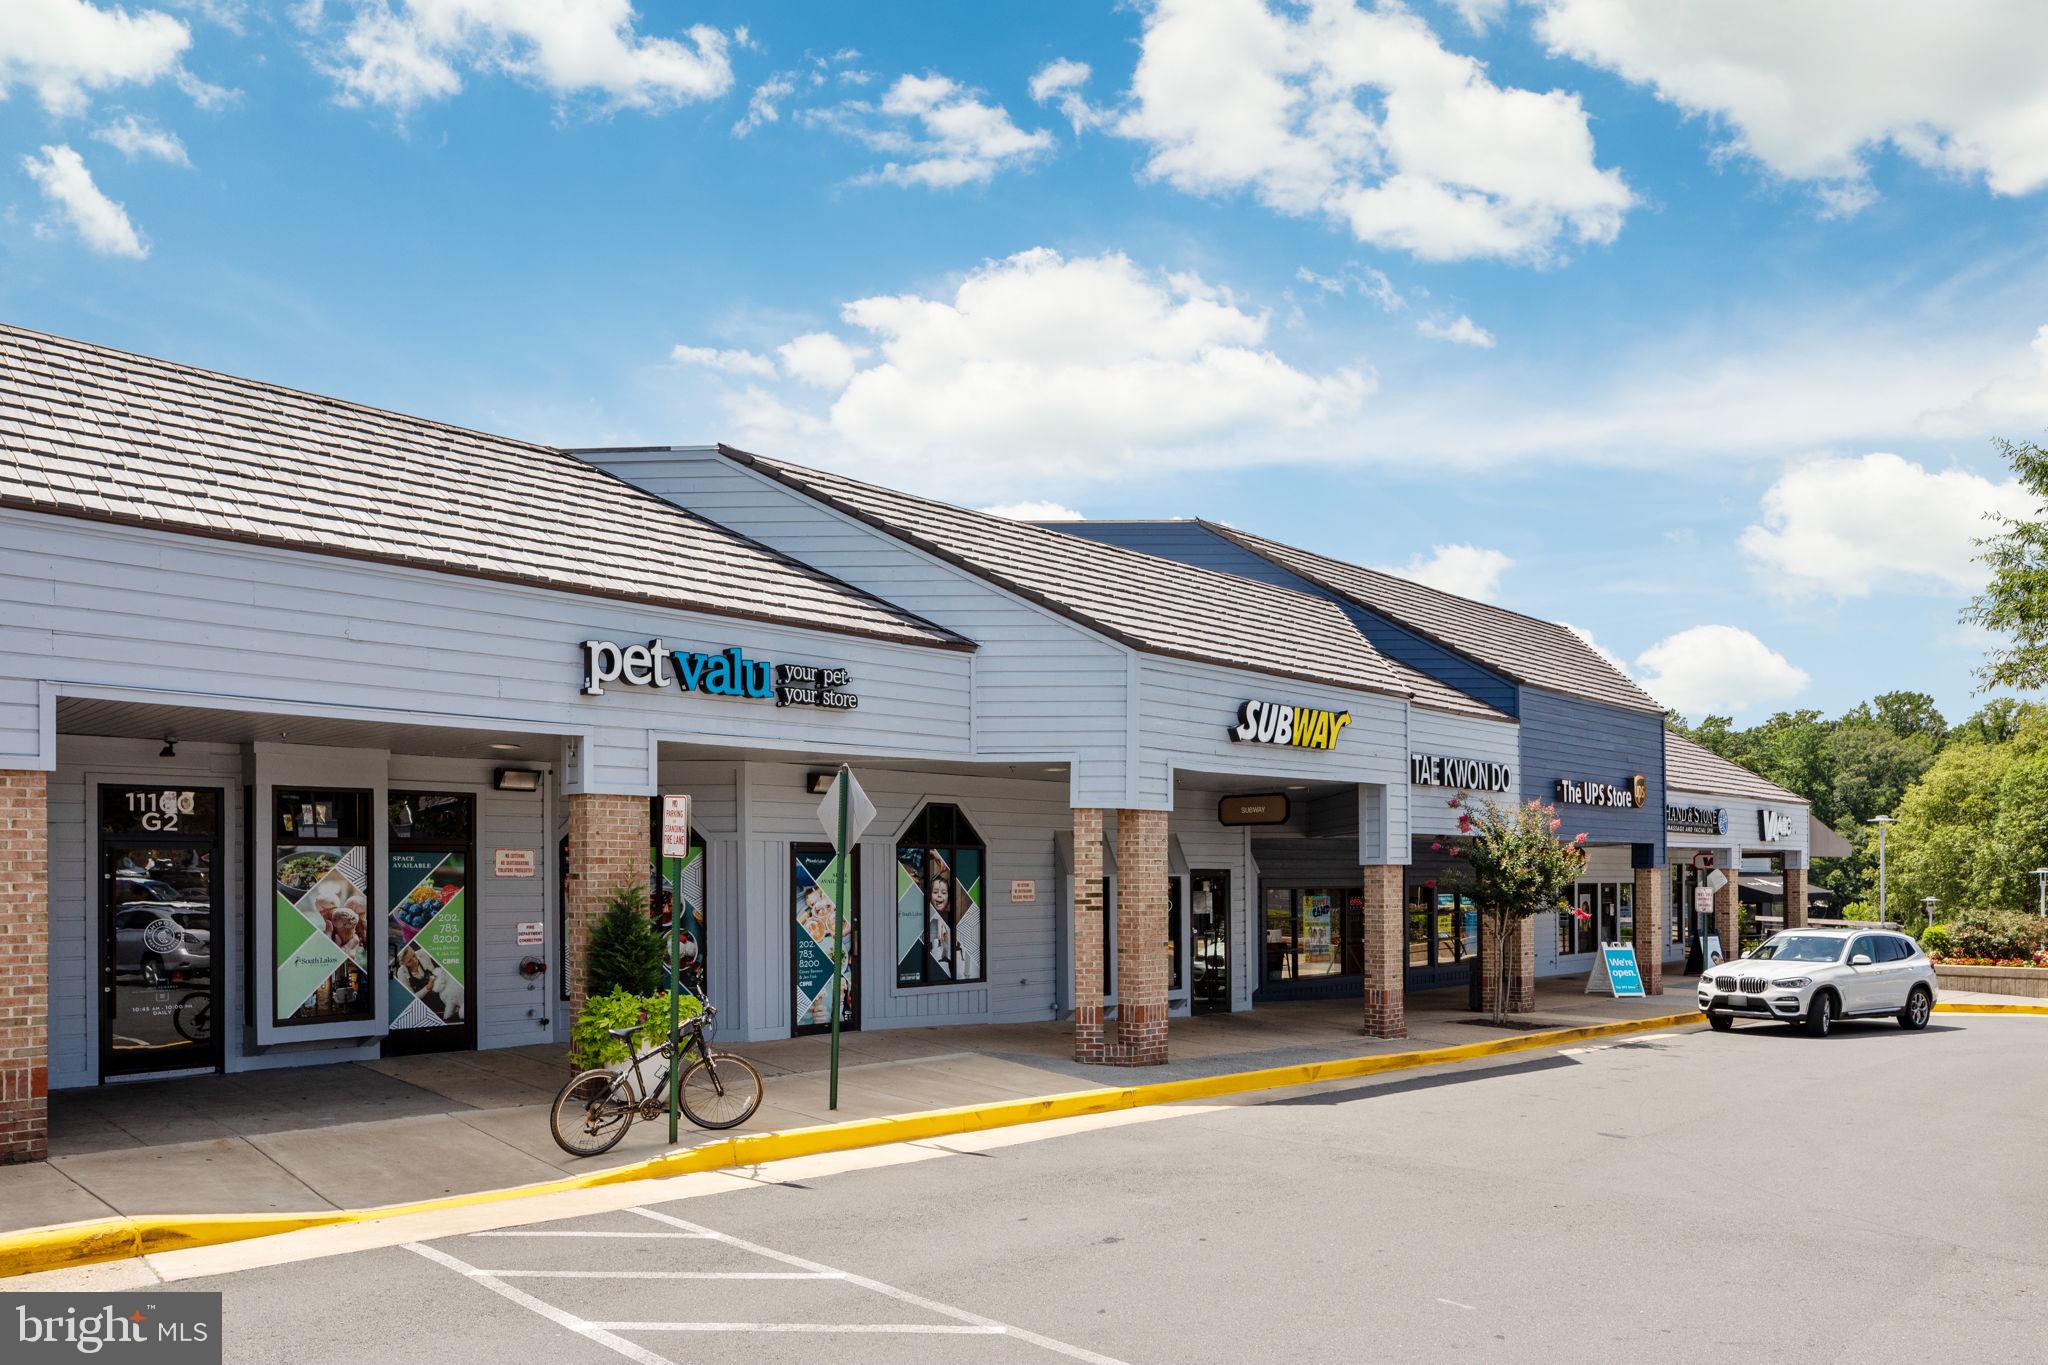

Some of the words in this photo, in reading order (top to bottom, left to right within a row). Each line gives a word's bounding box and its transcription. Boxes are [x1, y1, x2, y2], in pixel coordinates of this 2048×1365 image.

[586, 638, 671, 695] pet
[674, 647, 774, 698] valu
[784, 665, 817, 683] your
[784, 687, 817, 706] your
[823, 690, 857, 708] store
[1236, 700, 1352, 750] SUBWAY
[1412, 754, 1440, 786] TAE
[1443, 758, 1489, 790] KWON
[1492, 763, 1511, 793] DO
[1562, 779, 1582, 804] The
[1584, 781, 1605, 806] UPS
[1606, 784, 1632, 807] Store
[665, 809, 684, 818] PARKING
[1240, 806, 1266, 814] SUBWAY
[142, 812, 178, 831] G2
[664, 824, 685, 833] STANDING
[663, 834, 673, 845] FIRE
[673, 834, 685, 845] LANE
[432, 934, 460, 944] 8200
[301, 956, 320, 964] South
[798, 959, 820, 968] 8200
[1609, 957, 1634, 967] We're
[1612, 969, 1637, 979] open.
